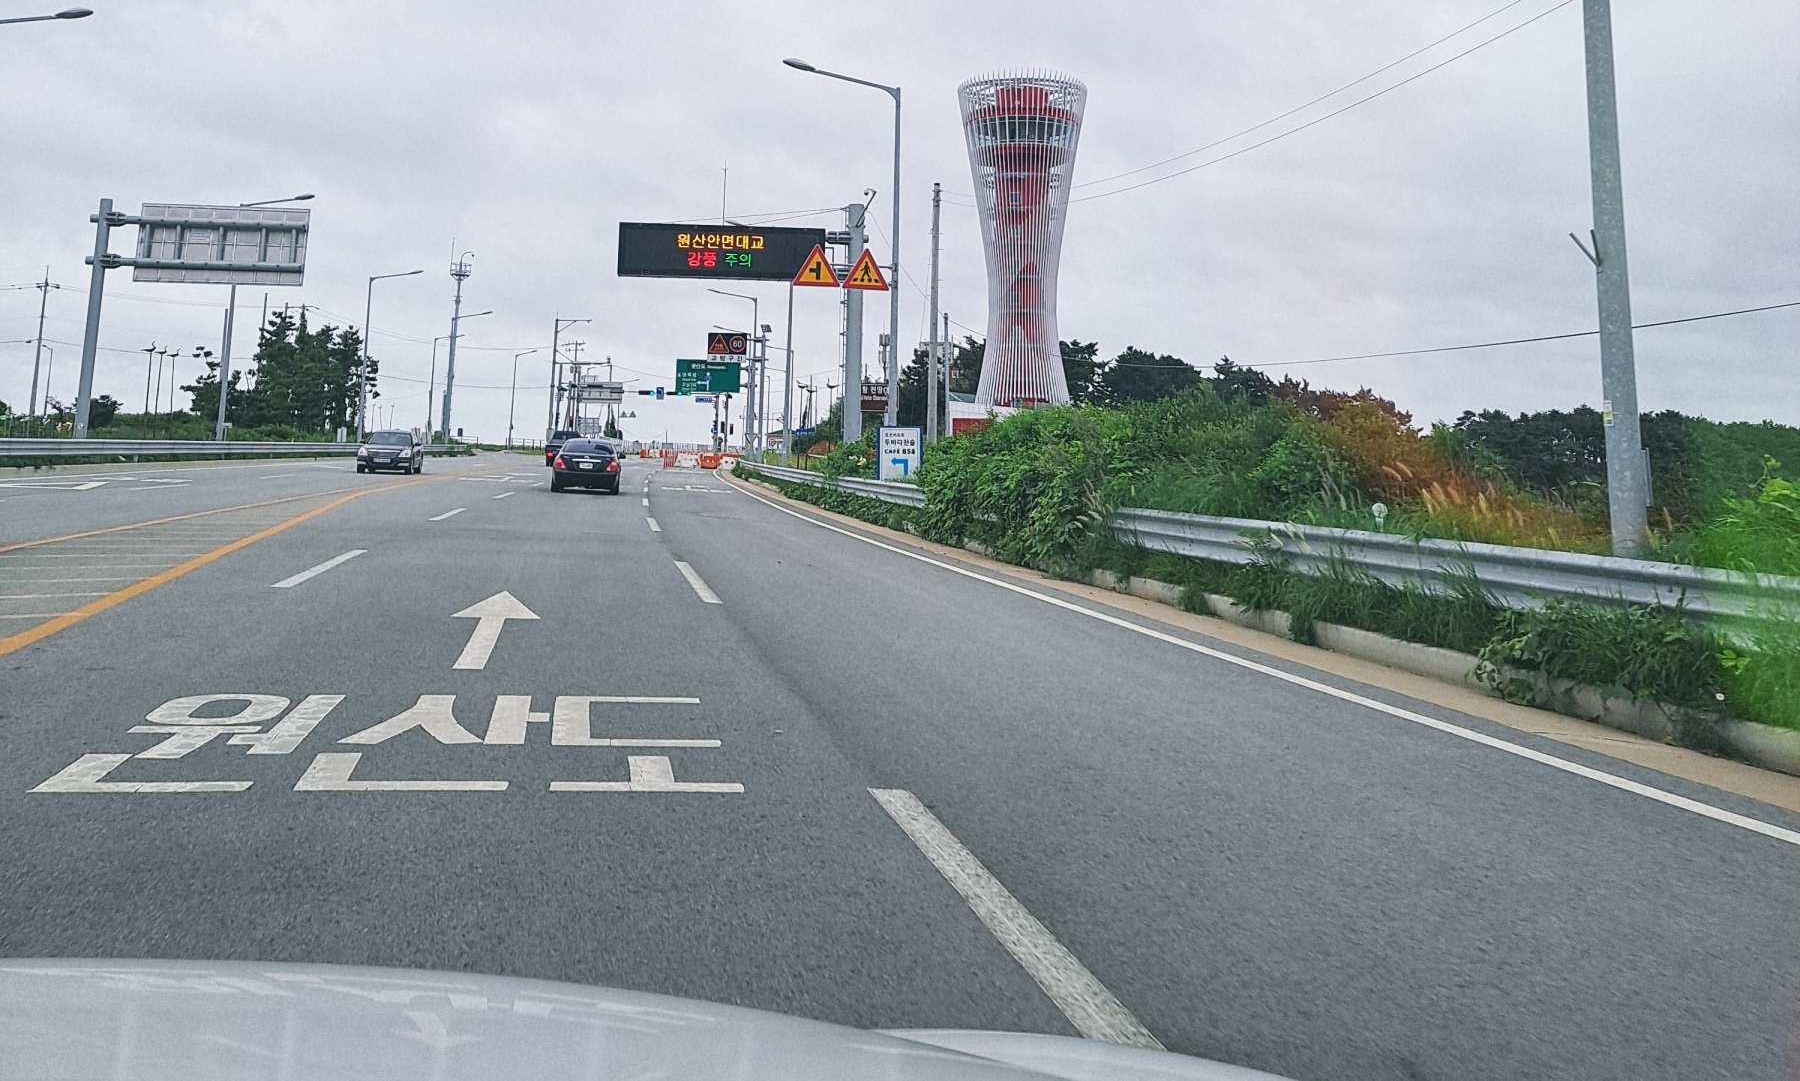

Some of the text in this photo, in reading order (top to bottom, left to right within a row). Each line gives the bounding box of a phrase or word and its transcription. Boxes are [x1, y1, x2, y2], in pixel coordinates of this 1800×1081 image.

[676, 233, 765, 250] 원산안면대교
[687, 251, 752, 267] 강풍 주의
[732, 339, 742, 349] 60
[26, 694, 745, 793] 원산도
